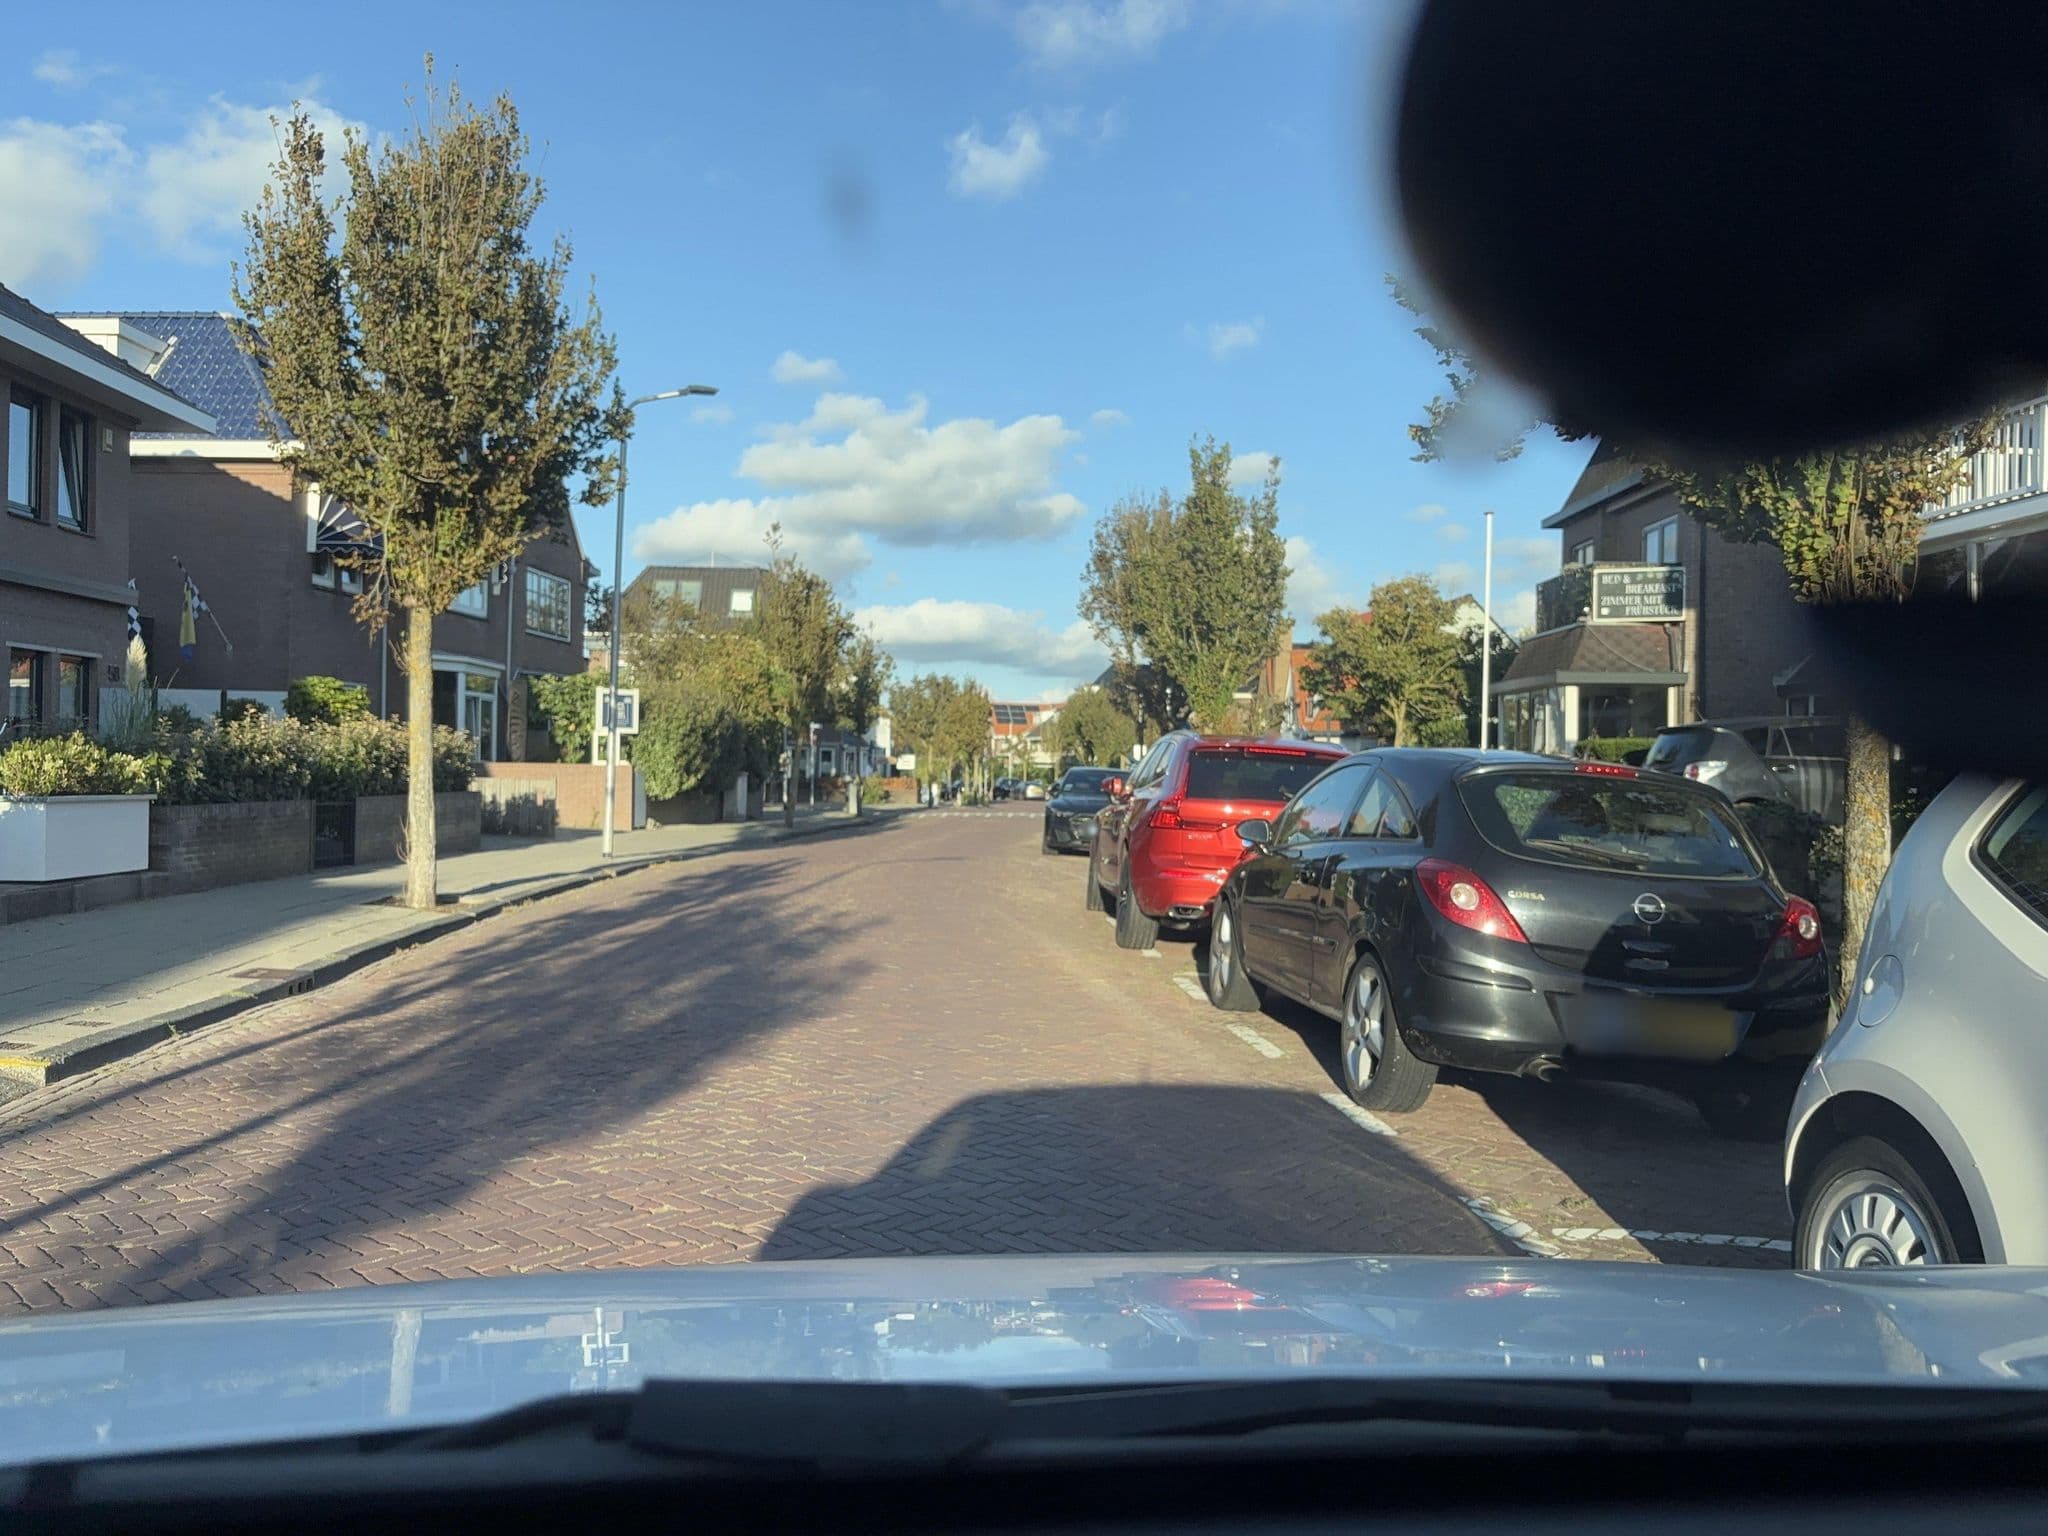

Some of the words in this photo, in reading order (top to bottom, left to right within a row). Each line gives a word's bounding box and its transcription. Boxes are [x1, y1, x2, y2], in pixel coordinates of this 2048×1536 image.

[1602, 574, 1621, 585] BED
[1623, 574, 1631, 583] &
[1601, 595, 1641, 606] ZIMMER
[1644, 595, 1663, 605] MIT
[1507, 890, 1546, 901] CORSA
